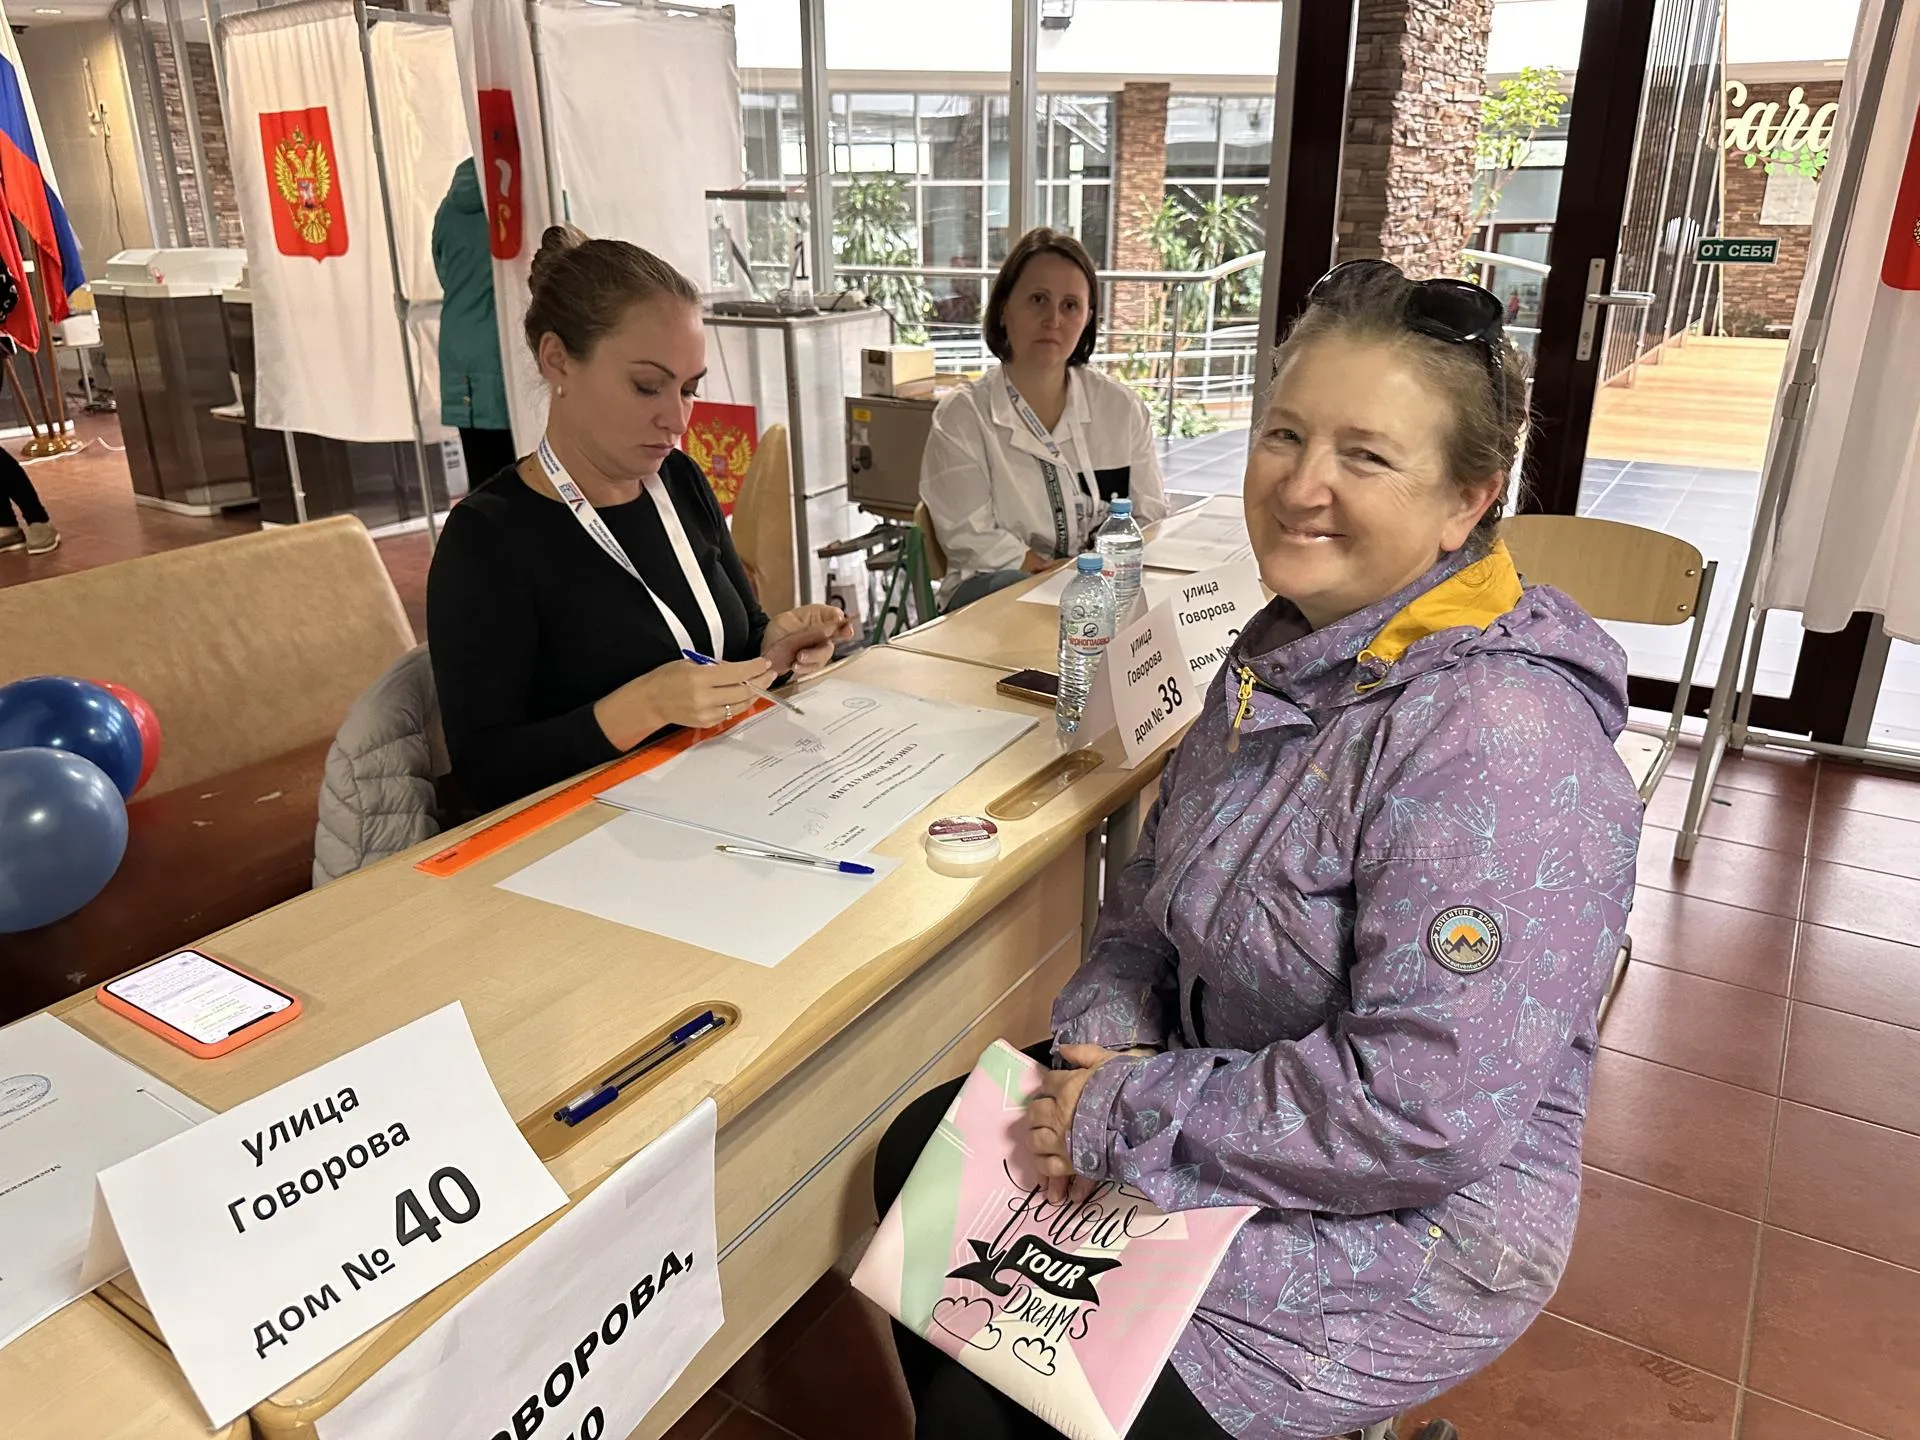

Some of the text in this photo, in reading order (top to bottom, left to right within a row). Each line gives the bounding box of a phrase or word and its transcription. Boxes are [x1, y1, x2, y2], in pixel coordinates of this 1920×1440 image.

[1701, 244, 1773, 258] ОТ СЕБЯ
[1182, 581, 1219, 603] улица
[1178, 601, 1236, 626] Говорова
[1130, 628, 1152, 658] улица
[1127, 650, 1162, 687] Говорова
[1189, 653, 1218, 671] дом
[1134, 676, 1182, 745] дом № 38
[1434, 909, 1496, 934] ADVENTURE SPIRIT
[241, 1087, 360, 1168] улица
[227, 1122, 411, 1234] Говорова
[253, 1166, 481, 1360] дом № 40
[1016, 1243, 1086, 1289] YOUR
